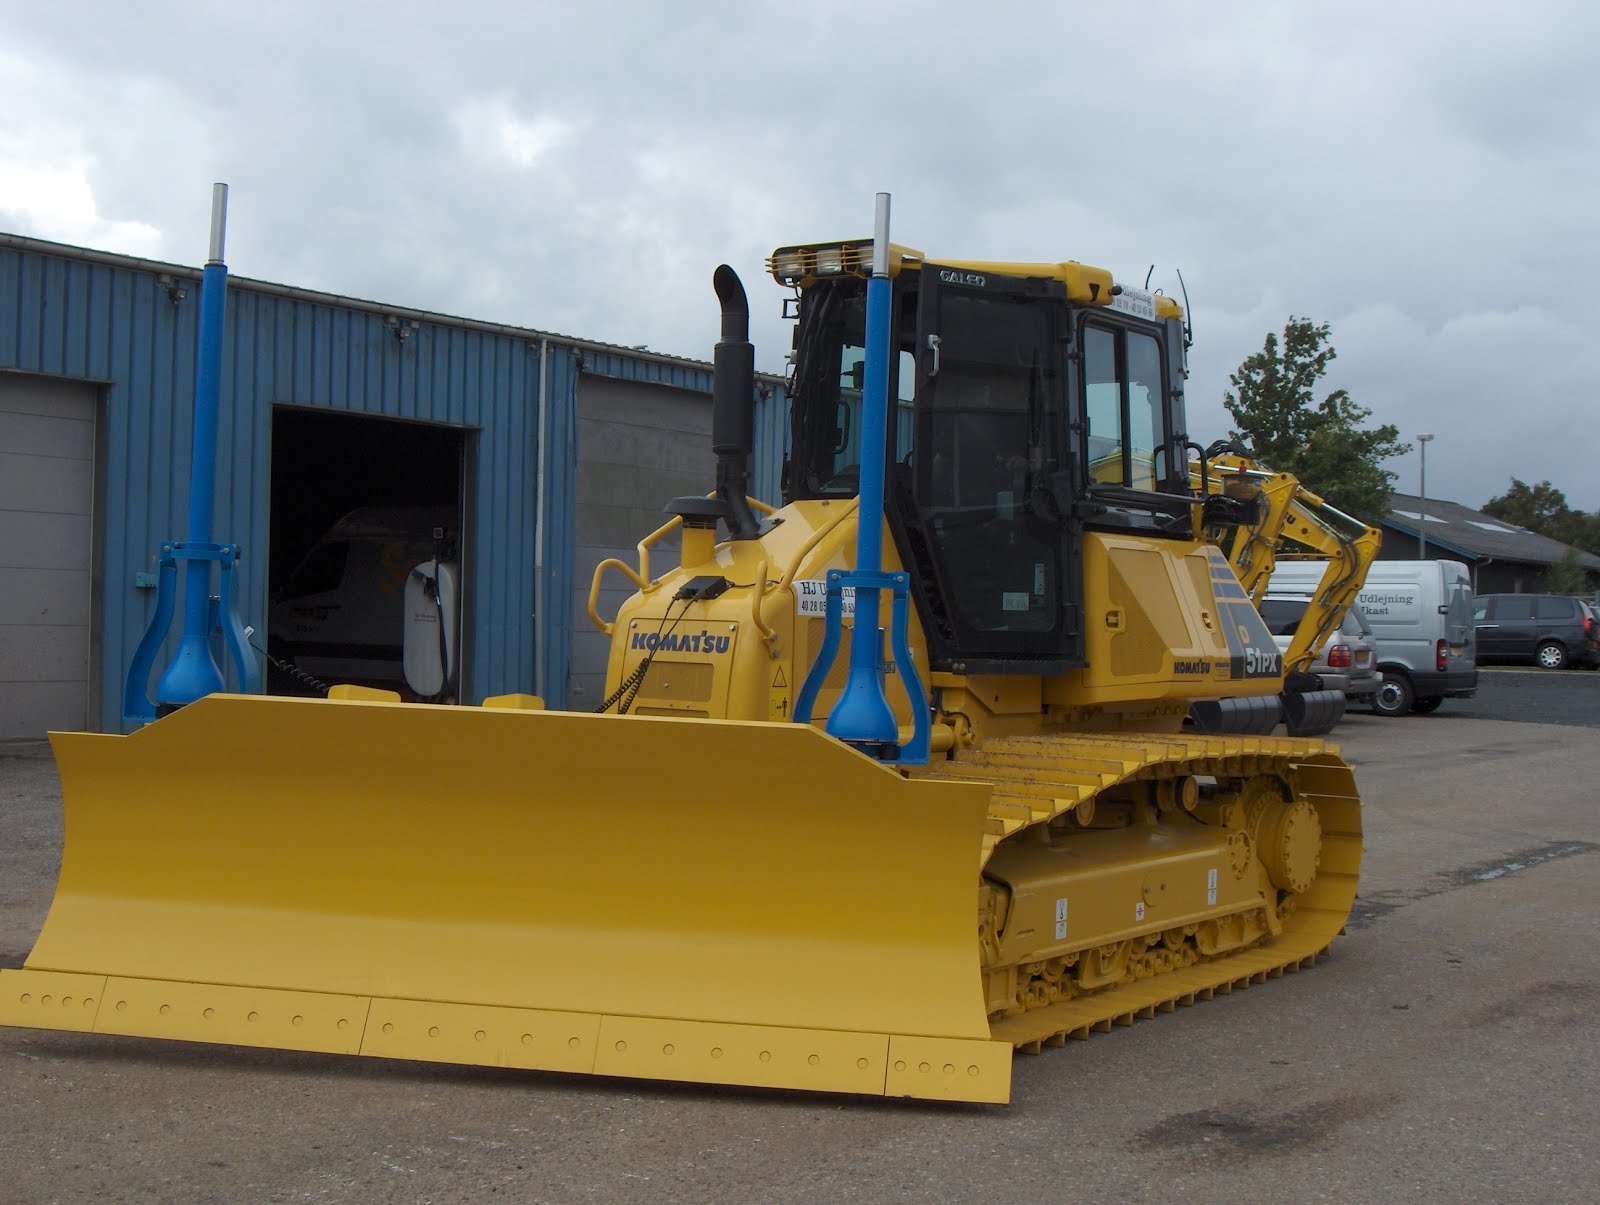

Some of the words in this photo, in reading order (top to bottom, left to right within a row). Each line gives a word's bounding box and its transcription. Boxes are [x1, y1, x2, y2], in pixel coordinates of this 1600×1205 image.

[801, 582, 817, 595] HJ
[801, 600, 809, 611] 40
[810, 601, 817, 611] 28
[1360, 594, 1414, 605] Udlejning
[1361, 606, 1389, 615] Ikast
[631, 630, 730, 653] KOMATSU
[1238, 625, 1250, 644] D
[1174, 659, 1211, 674] KOMATSU
[1245, 647, 1277, 674] 51PX
